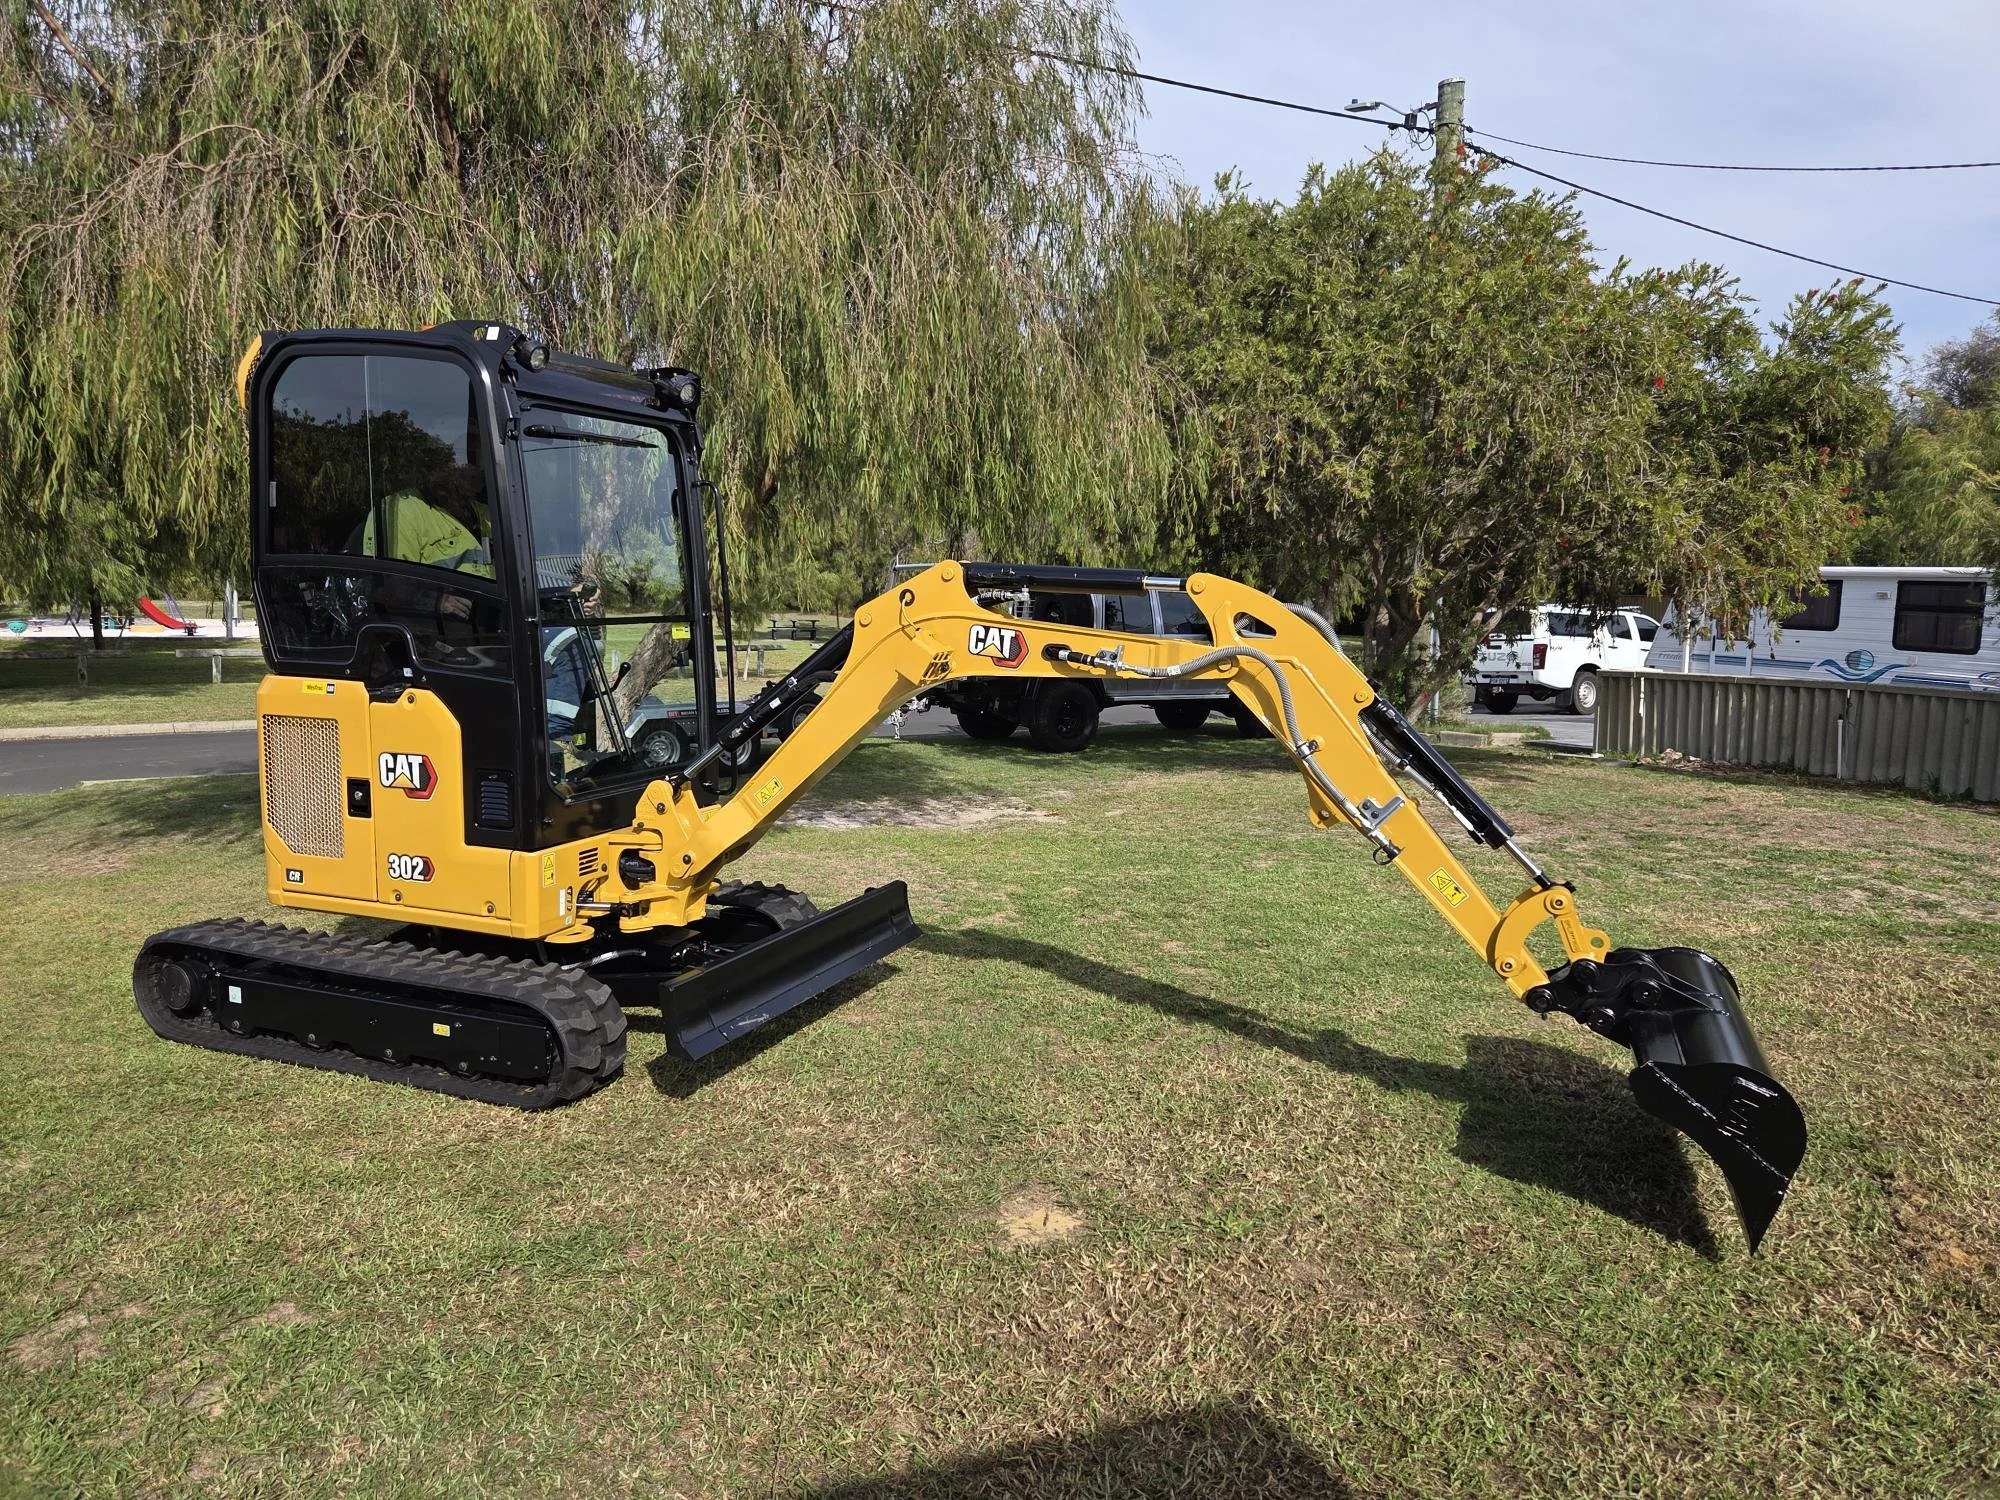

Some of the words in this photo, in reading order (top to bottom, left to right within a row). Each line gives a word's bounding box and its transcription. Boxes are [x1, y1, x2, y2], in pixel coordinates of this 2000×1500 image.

[969, 625, 1015, 659] CAT
[379, 753, 422, 789] CAT
[290, 871, 300, 881] CR
[388, 854, 424, 880] 302
